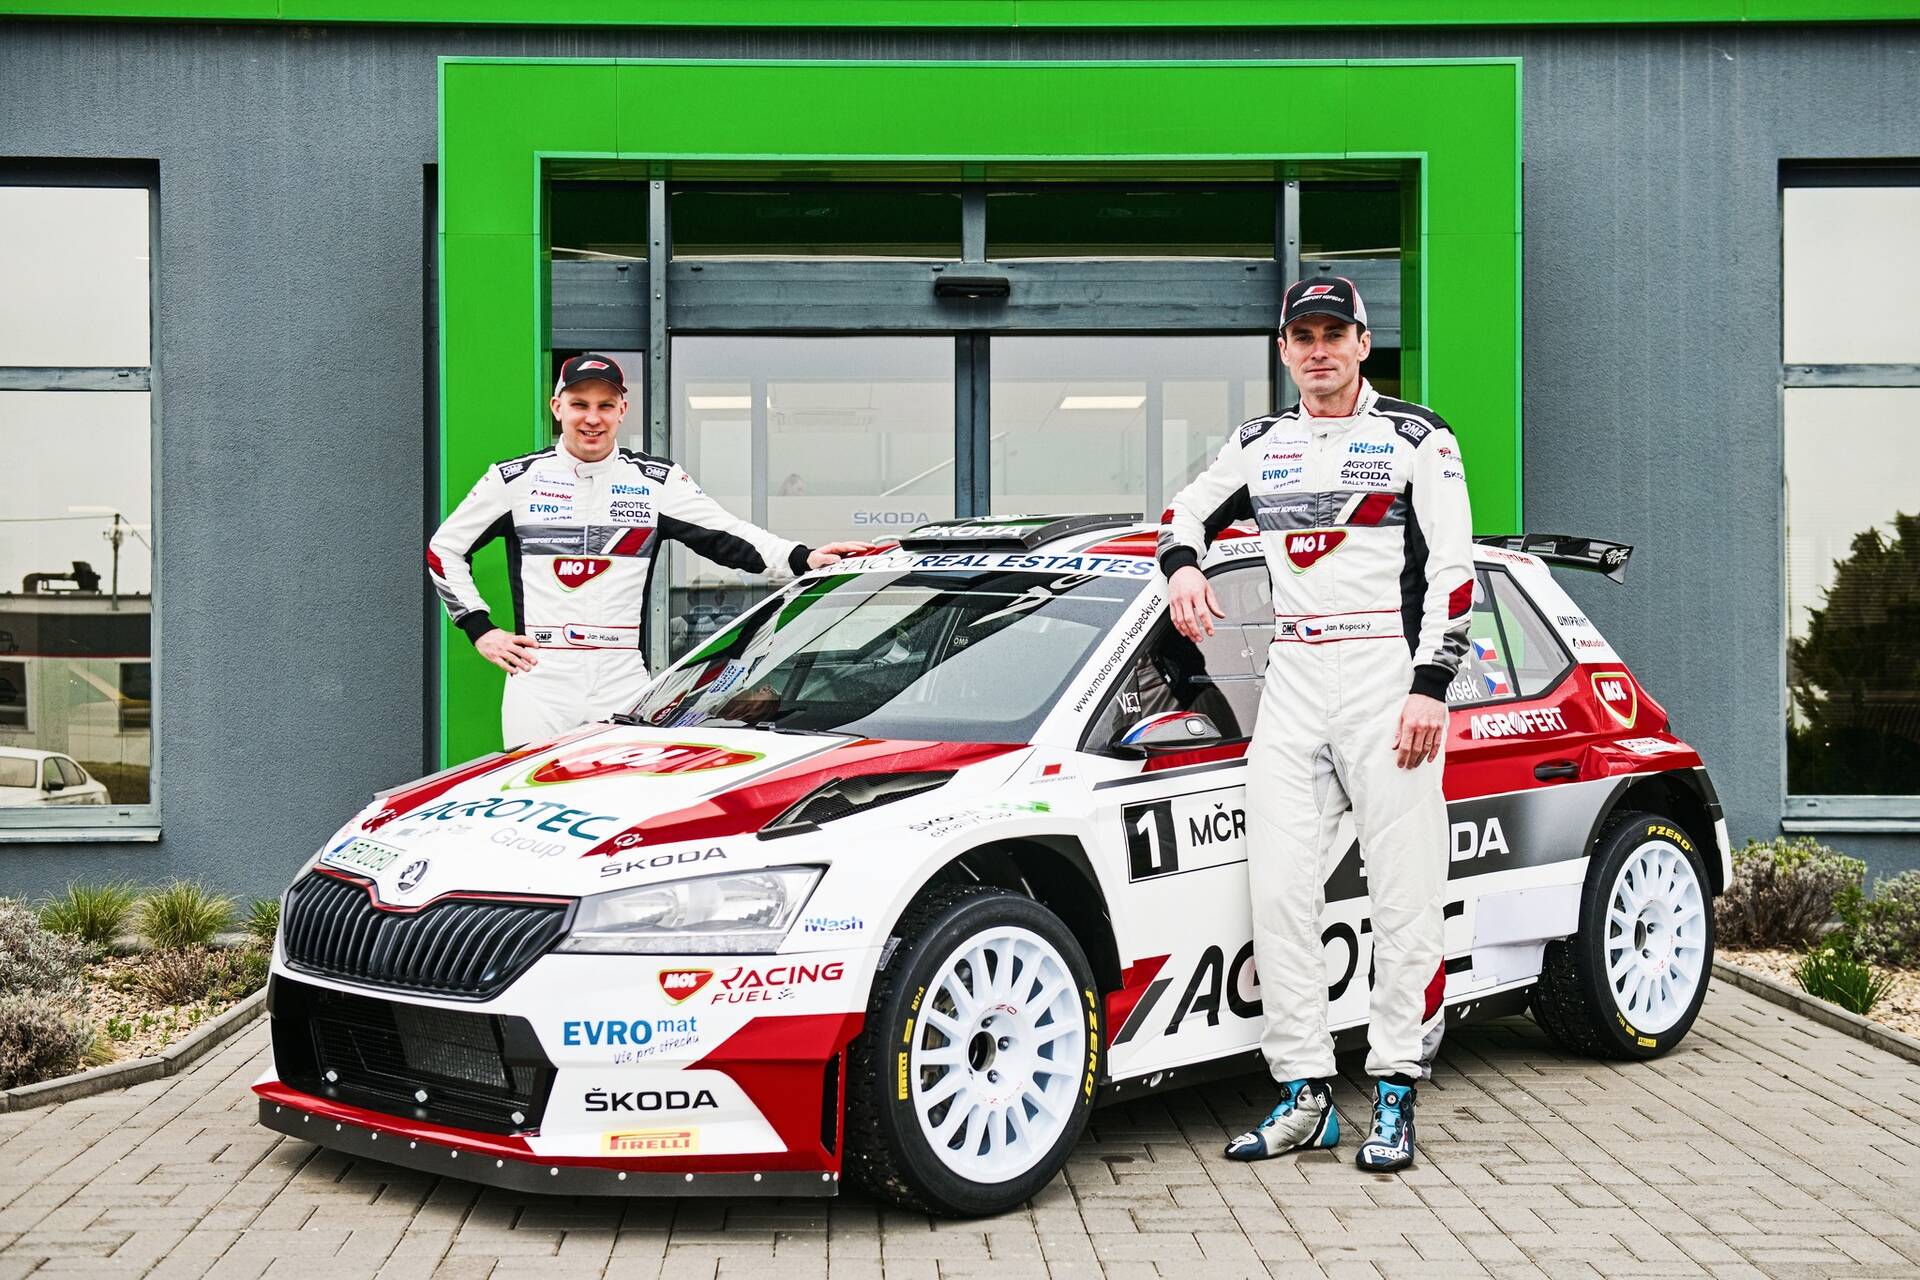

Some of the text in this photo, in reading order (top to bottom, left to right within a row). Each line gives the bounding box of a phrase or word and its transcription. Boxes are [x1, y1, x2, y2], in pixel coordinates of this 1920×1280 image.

[1241, 423, 1263, 441] OMP
[1400, 421, 1426, 441] OMP
[1349, 442, 1395, 454] iWash
[1272, 452, 1303, 460] Matador
[503, 463, 524, 477] OMP
[1343, 460, 1392, 470] AGROTEC
[645, 466, 666, 479] OMP
[1262, 469, 1289, 480] EVRO
[1340, 469, 1391, 481] ŠKODA
[540, 491, 572, 499] Matador
[611, 484, 650, 495] iWash
[529, 504, 558, 513] EVRO
[610, 500, 651, 510] AGROTEC
[610, 509, 651, 518] ŠKODA
[853, 511, 930, 524] ŠKODA
[907, 525, 1024, 538] ŠKODA
[912, 555, 990, 568] REAL
[999, 555, 1155, 576] ESTATES
[1340, 622, 1371, 632] Kopecký
[535, 631, 552, 643] OMP
[1579, 639, 1605, 648] Matador
[1073, 595, 1162, 713] www.motorsport-kopecky.cz
[1600, 681, 1627, 701] MOL
[1471, 706, 1568, 740] AGROFERT
[398, 797, 620, 842] AGROTEC
[490, 828, 567, 858] Group
[1136, 809, 1162, 869] 1
[600, 847, 728, 878] ŠKODA
[805, 916, 864, 933] iWash
[664, 962, 844, 990] MOL RACING
[710, 990, 773, 1006] FUEL
[563, 1016, 697, 1046] EVRO mat
[584, 1087, 719, 1112] ŠKODA
[610, 1132, 691, 1150] PIRELLI
